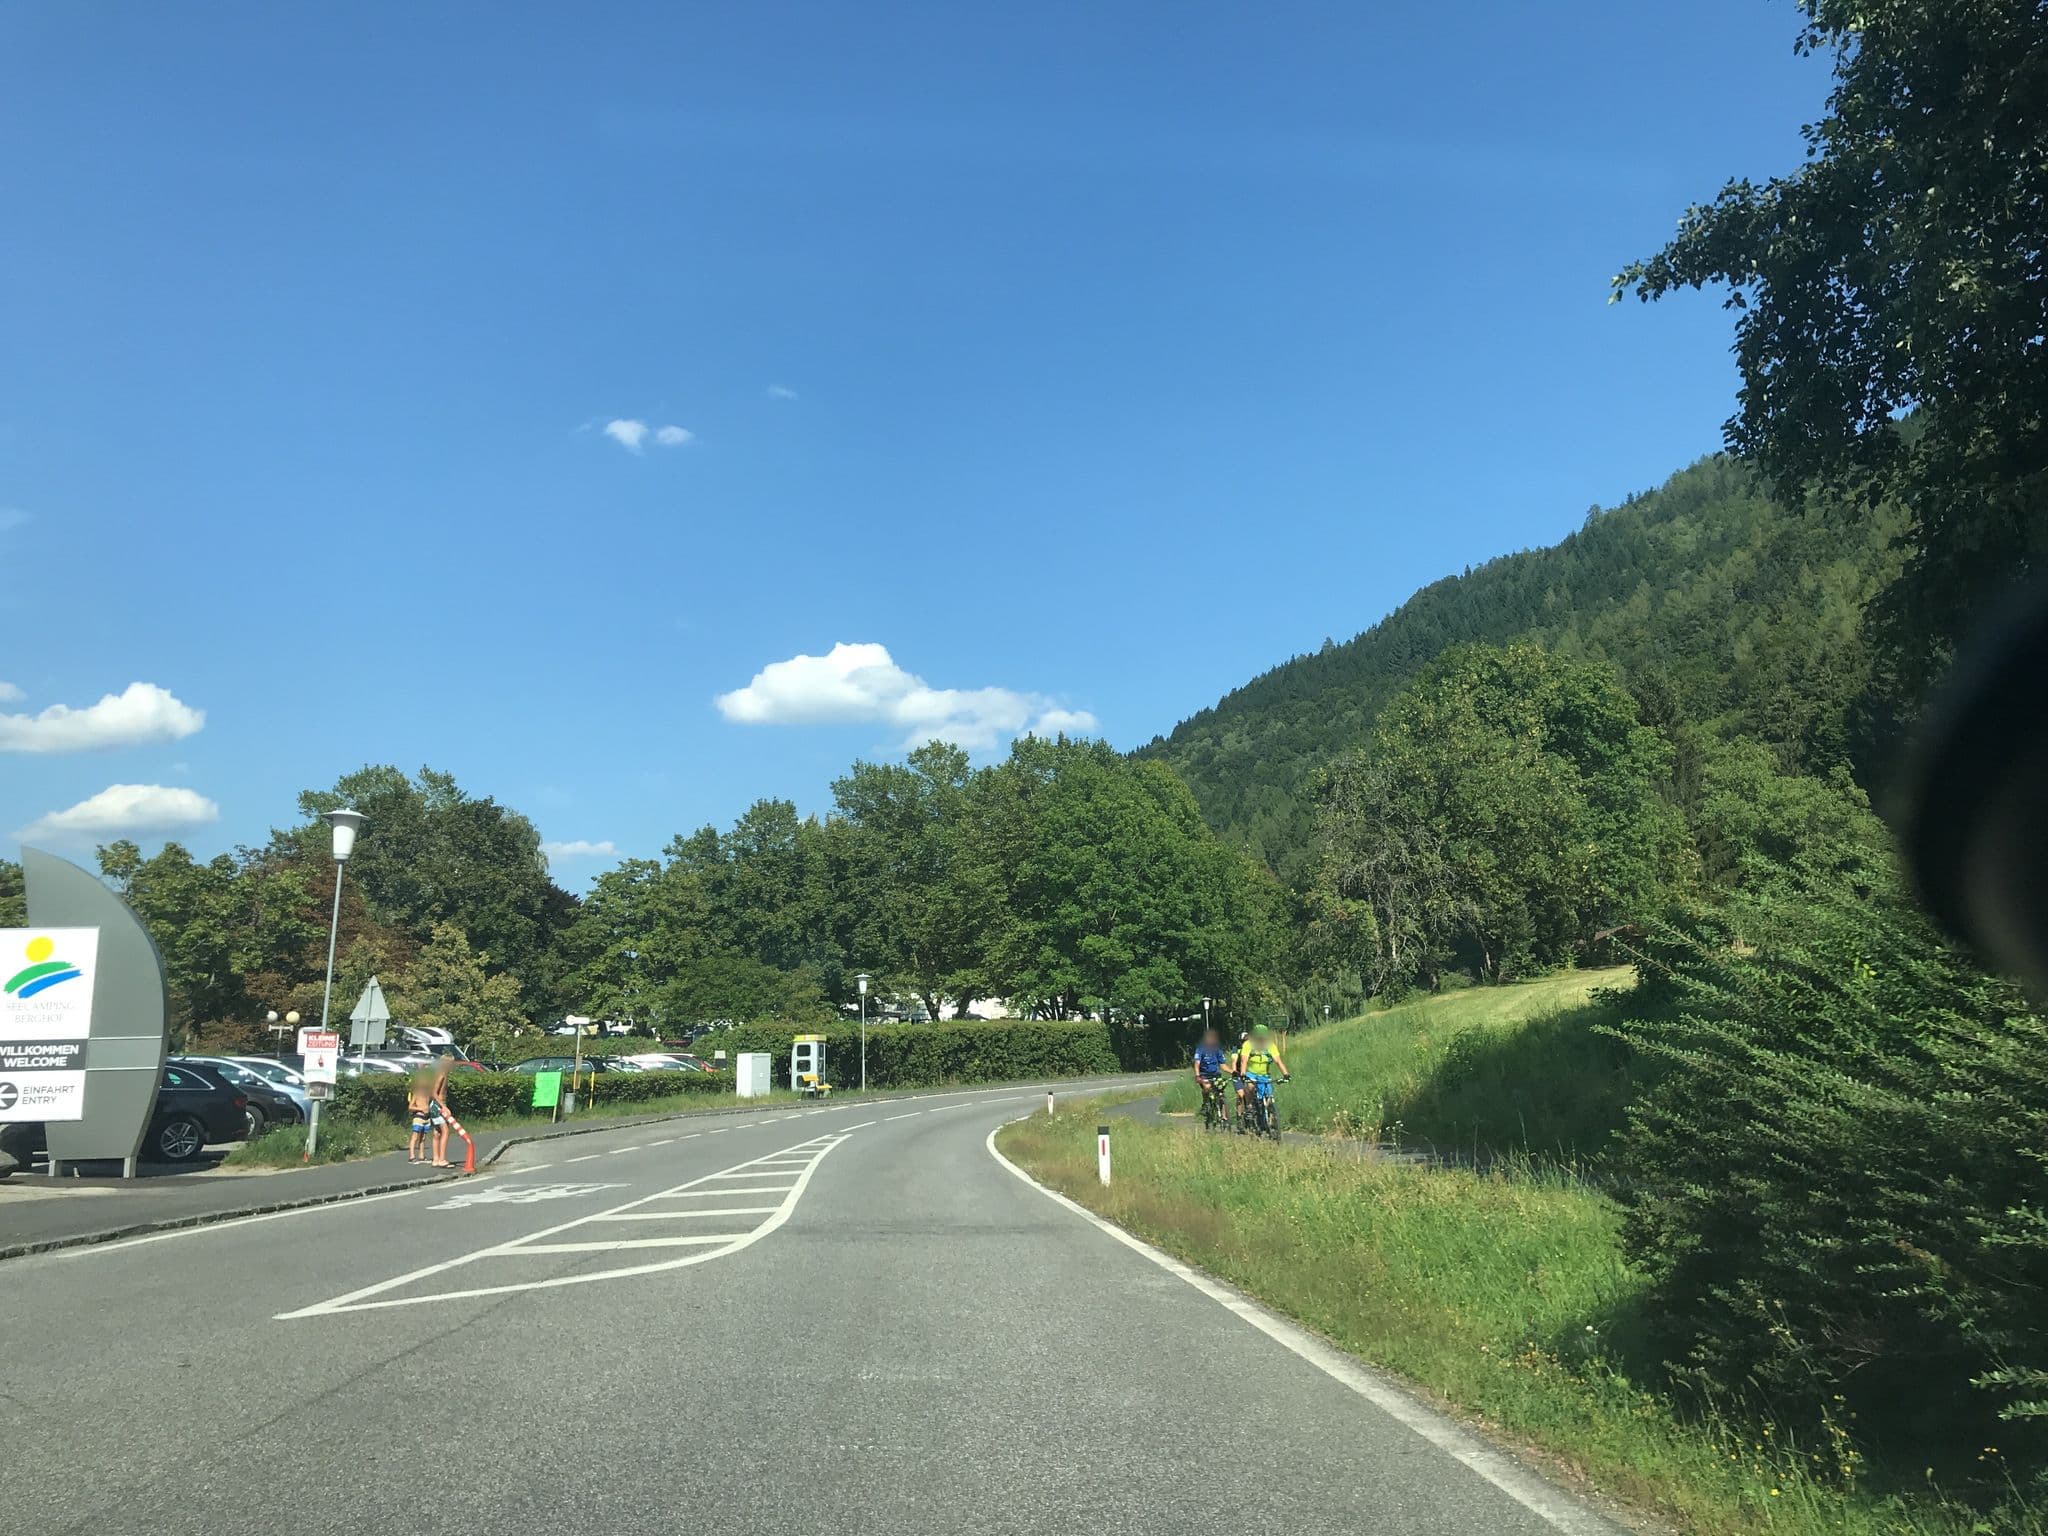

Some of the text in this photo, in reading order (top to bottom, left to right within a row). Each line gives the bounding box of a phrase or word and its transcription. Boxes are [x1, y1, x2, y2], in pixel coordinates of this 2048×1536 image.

[15, 1014, 64, 1023] BERGHOF
[4, 1056, 68, 1067] WELCOME
[23, 1086, 75, 1095] EINFAHRT
[22, 1096, 57, 1105] ENTRY
